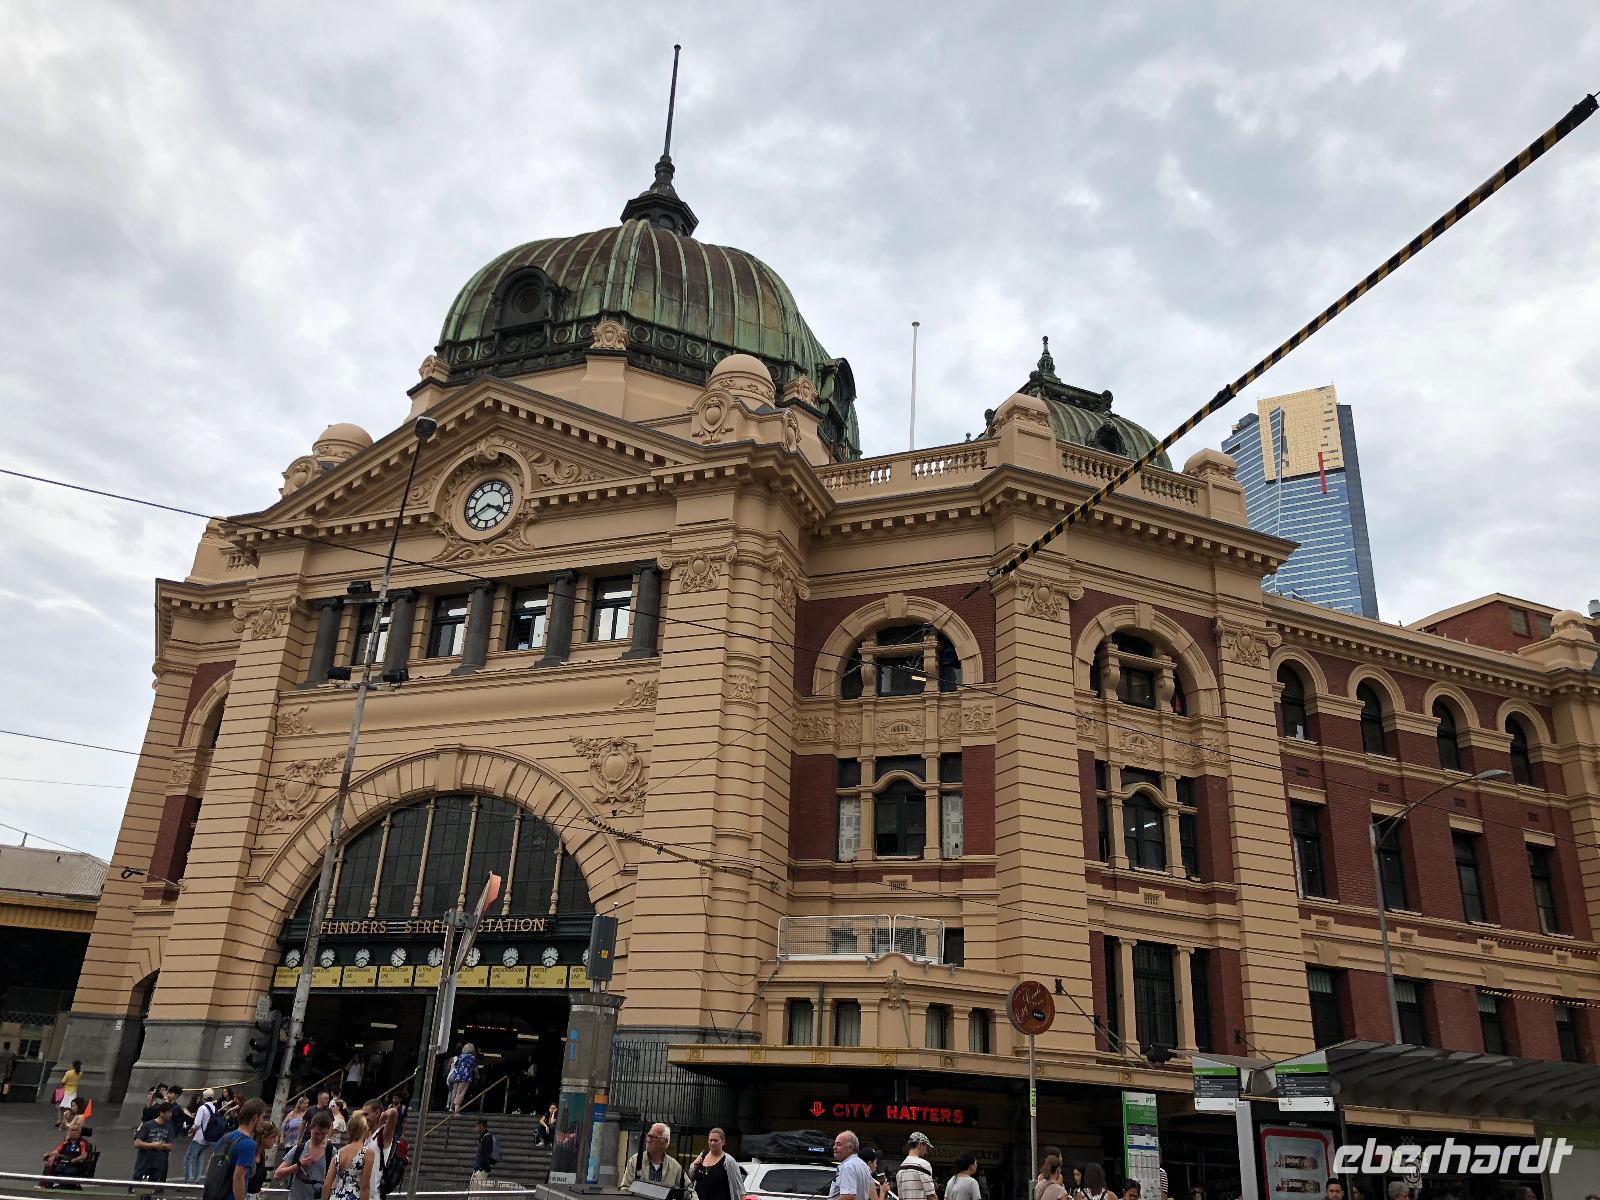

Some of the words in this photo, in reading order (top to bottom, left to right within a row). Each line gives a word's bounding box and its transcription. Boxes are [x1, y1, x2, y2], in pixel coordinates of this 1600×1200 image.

[320, 920, 387, 934] FLINDERS
[405, 919, 449, 933] STREE
[832, 1103, 873, 1119] CITY
[886, 1105, 964, 1124] HATTERS
